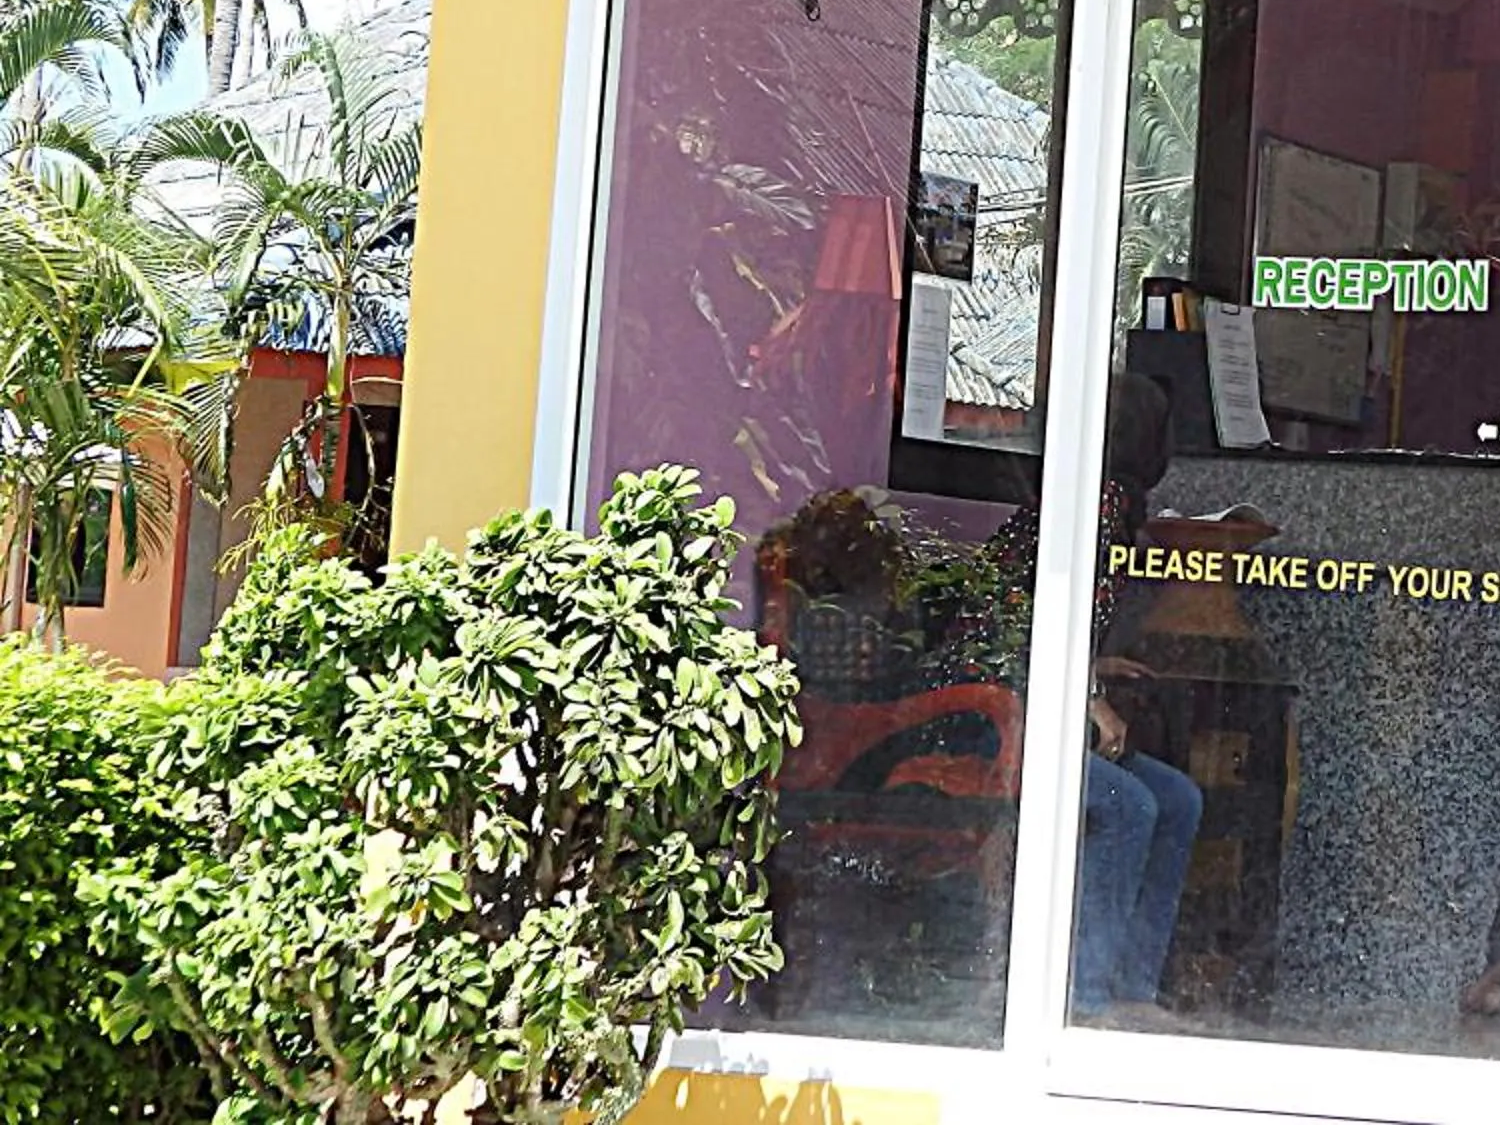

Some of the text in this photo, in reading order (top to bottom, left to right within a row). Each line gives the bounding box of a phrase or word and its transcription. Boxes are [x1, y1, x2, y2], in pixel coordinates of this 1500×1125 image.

[1253, 257, 1490, 312] RECEPTION
[1108, 545, 1224, 583] PLEASE
[1232, 553, 1309, 589] TAKE
[1316, 559, 1376, 593] OFF
[1387, 564, 1472, 602] YOUR
